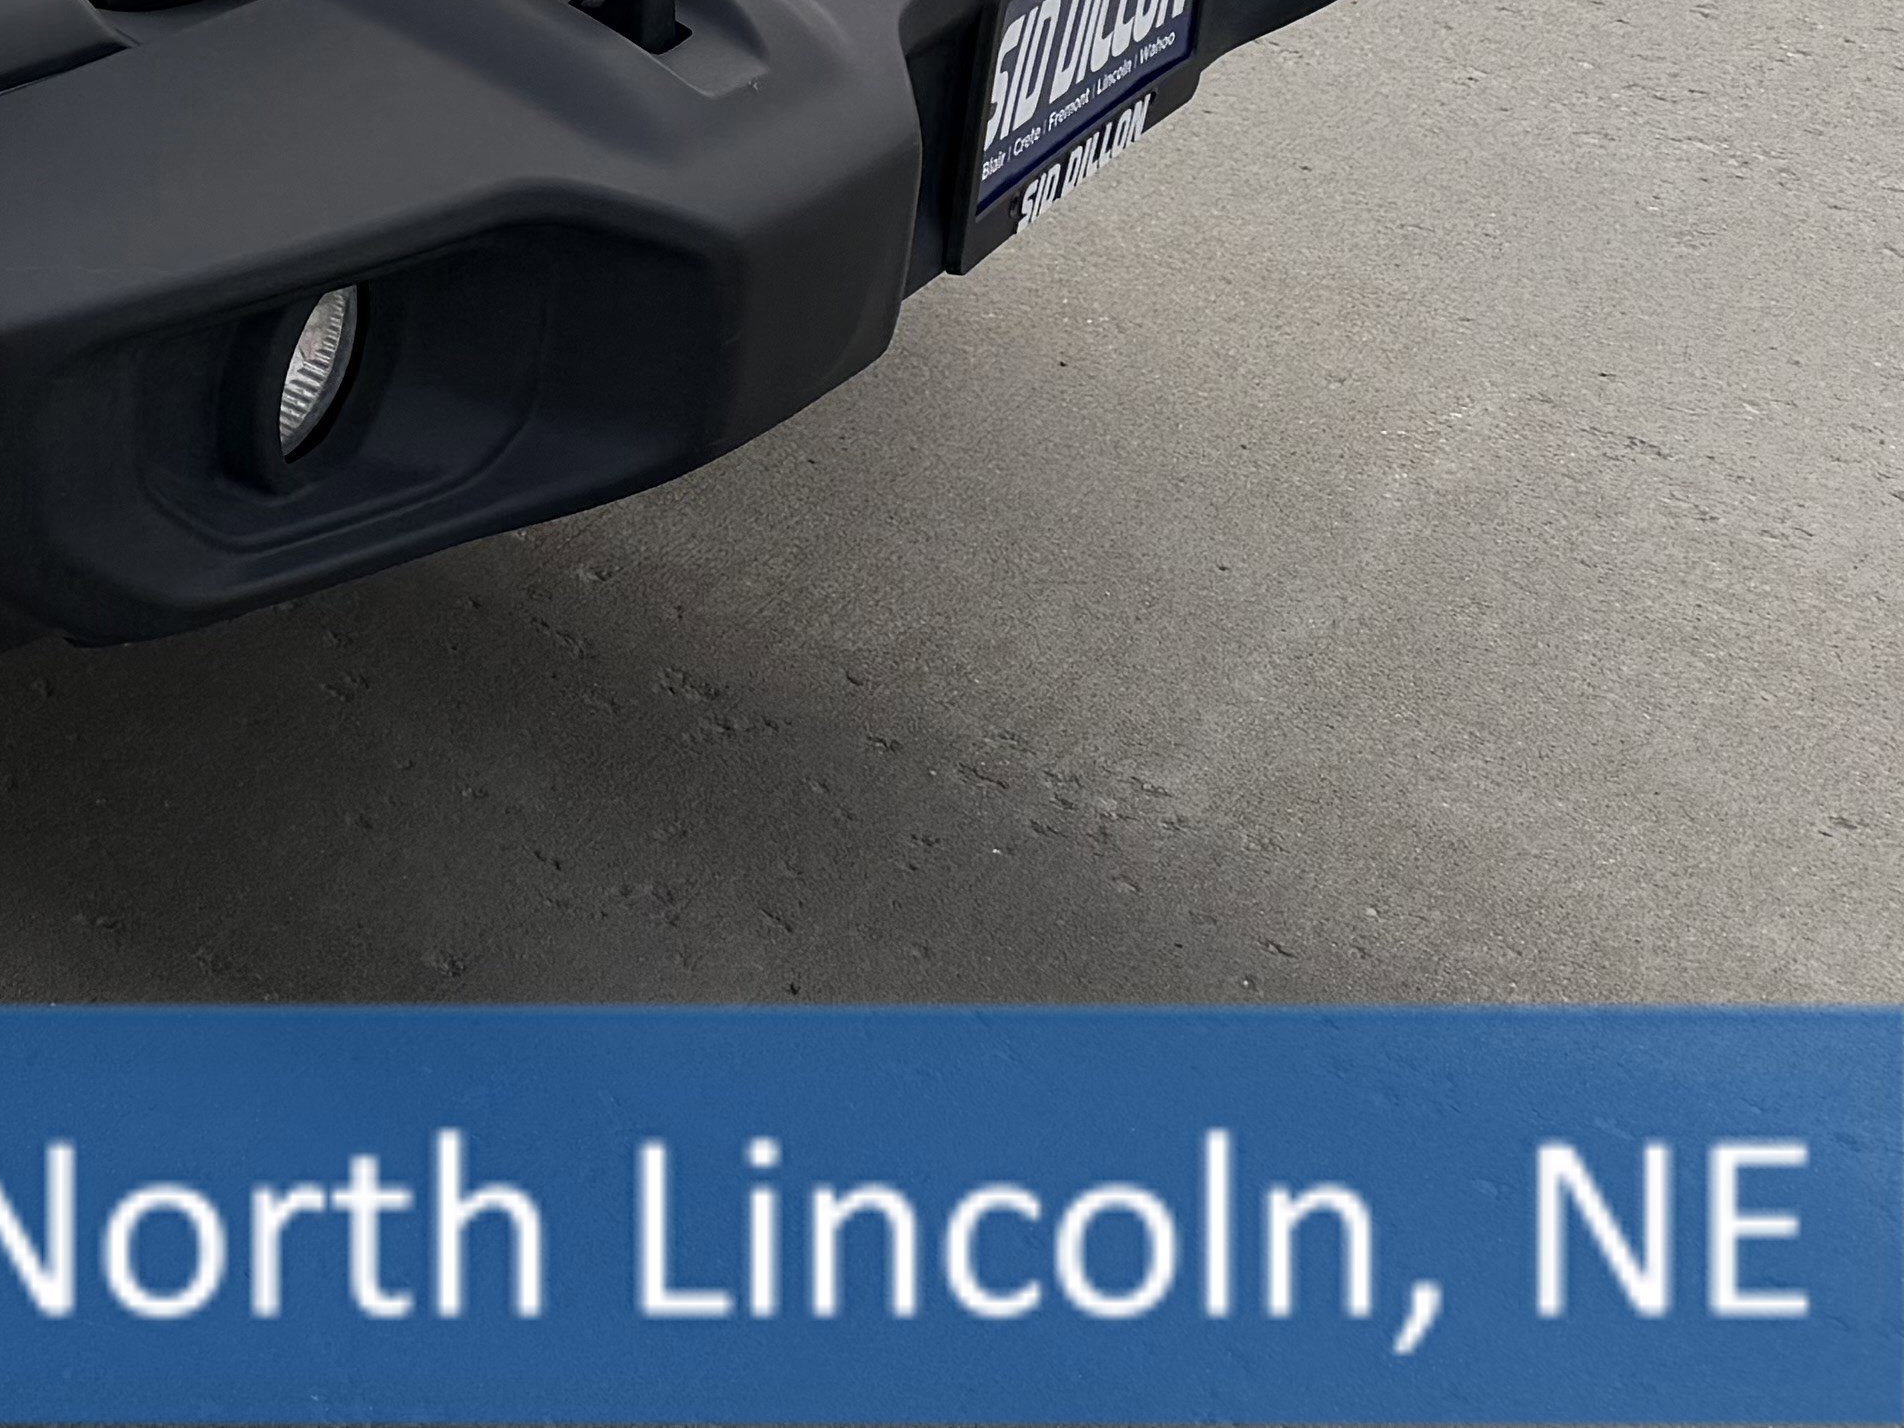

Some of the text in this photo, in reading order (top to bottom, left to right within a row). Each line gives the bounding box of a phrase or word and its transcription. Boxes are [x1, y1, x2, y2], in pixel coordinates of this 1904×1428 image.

[981, 31, 1176, 181] Blair Crete Fremont Lincoln Wahoo
[1016, 92, 1152, 234] SID DILLON
